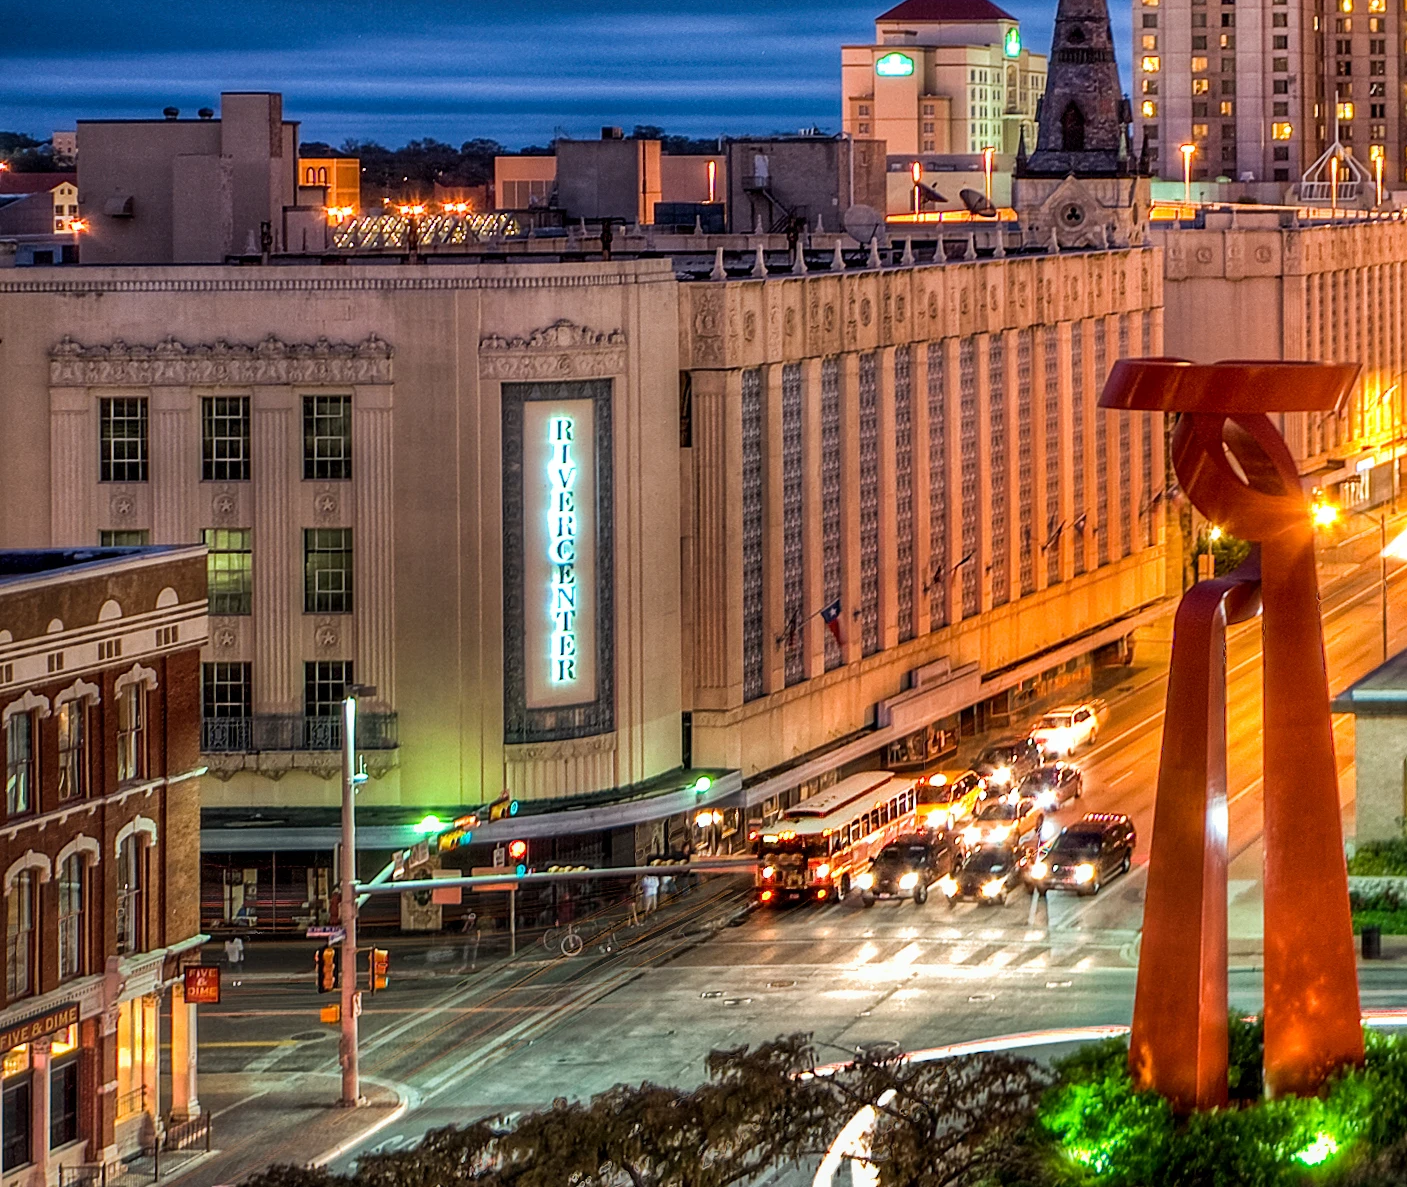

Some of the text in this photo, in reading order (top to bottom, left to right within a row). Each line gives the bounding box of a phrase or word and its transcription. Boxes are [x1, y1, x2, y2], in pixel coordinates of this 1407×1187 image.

[554, 418, 578, 682] RIVERCENTER
[188, 968, 217, 978] FIVE
[187, 986, 217, 996] DIME
[0, 1006, 77, 1052] FIVE & DIME
